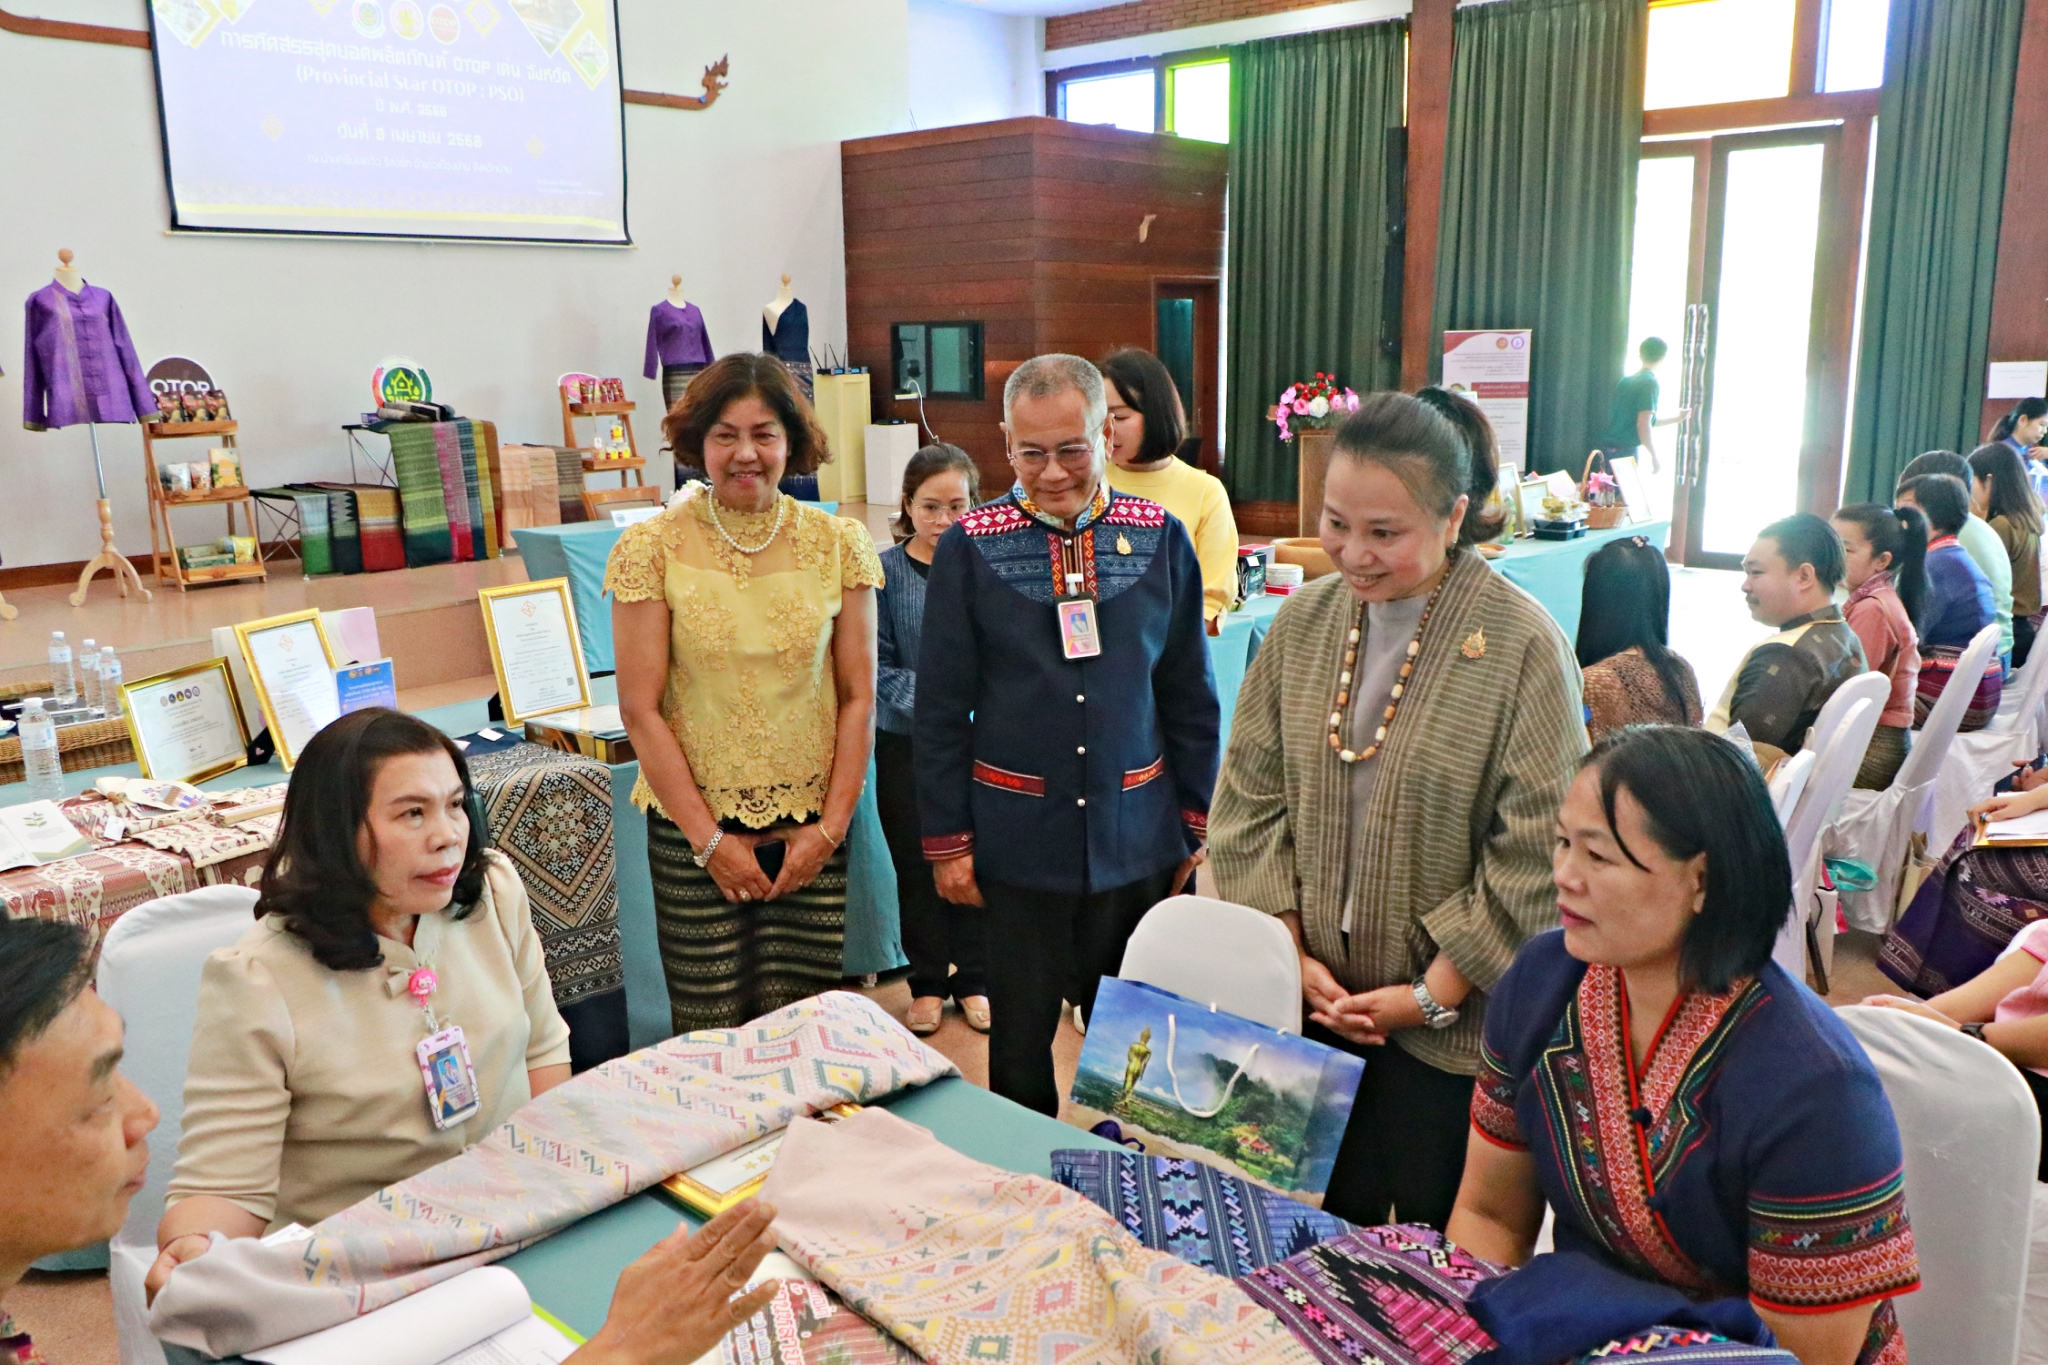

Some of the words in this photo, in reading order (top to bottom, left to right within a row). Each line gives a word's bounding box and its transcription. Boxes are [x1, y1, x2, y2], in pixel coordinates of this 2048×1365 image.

[453, 56, 491, 74] OTOP
[296, 63, 389, 88] (Provincial
[393, 74, 428, 92] Star
[432, 78, 476, 97] OTOP
[489, 84, 525, 103] PSO)
[418, 104, 448, 118] 2568
[447, 132, 483, 148] 2568
